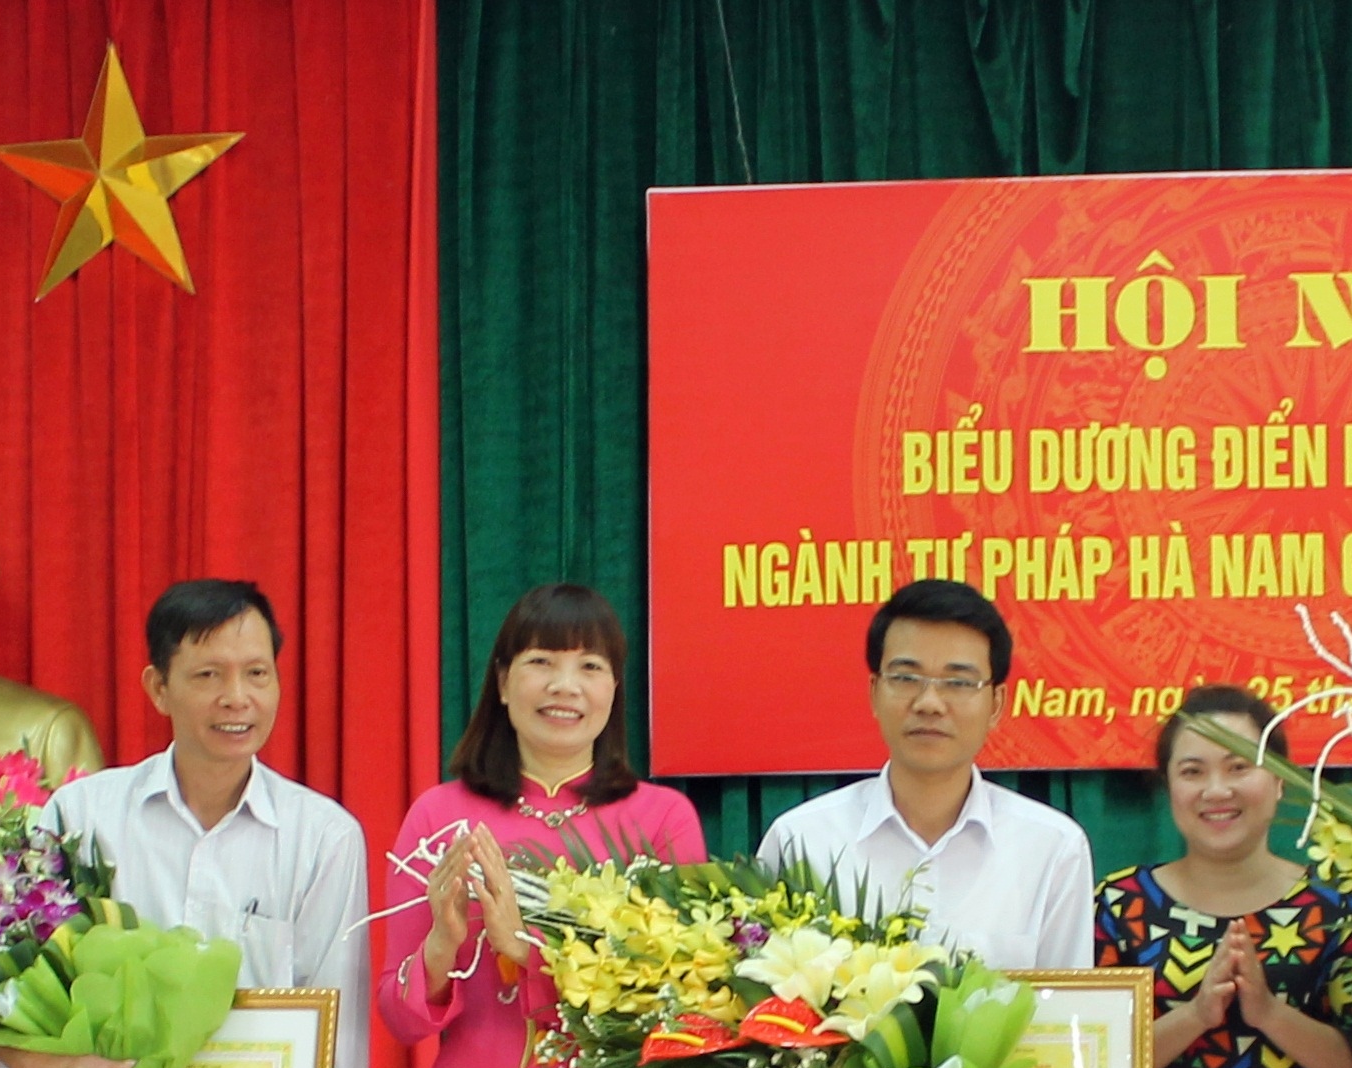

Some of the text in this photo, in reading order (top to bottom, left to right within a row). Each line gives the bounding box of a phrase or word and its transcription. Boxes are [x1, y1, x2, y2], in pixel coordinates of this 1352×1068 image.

[1022, 249, 1246, 380] HỘI
[902, 403, 1014, 495] BIỂU
[1029, 421, 1197, 493] DƯƠNG
[1210, 397, 1328, 490] ĐIỂN
[722, 528, 892, 608] NGÀNH
[981, 522, 1113, 602] PHÁP
[1128, 520, 1196, 600] HÀ
[1209, 532, 1326, 598] NAM
[1011, 678, 1117, 724] Nam,
